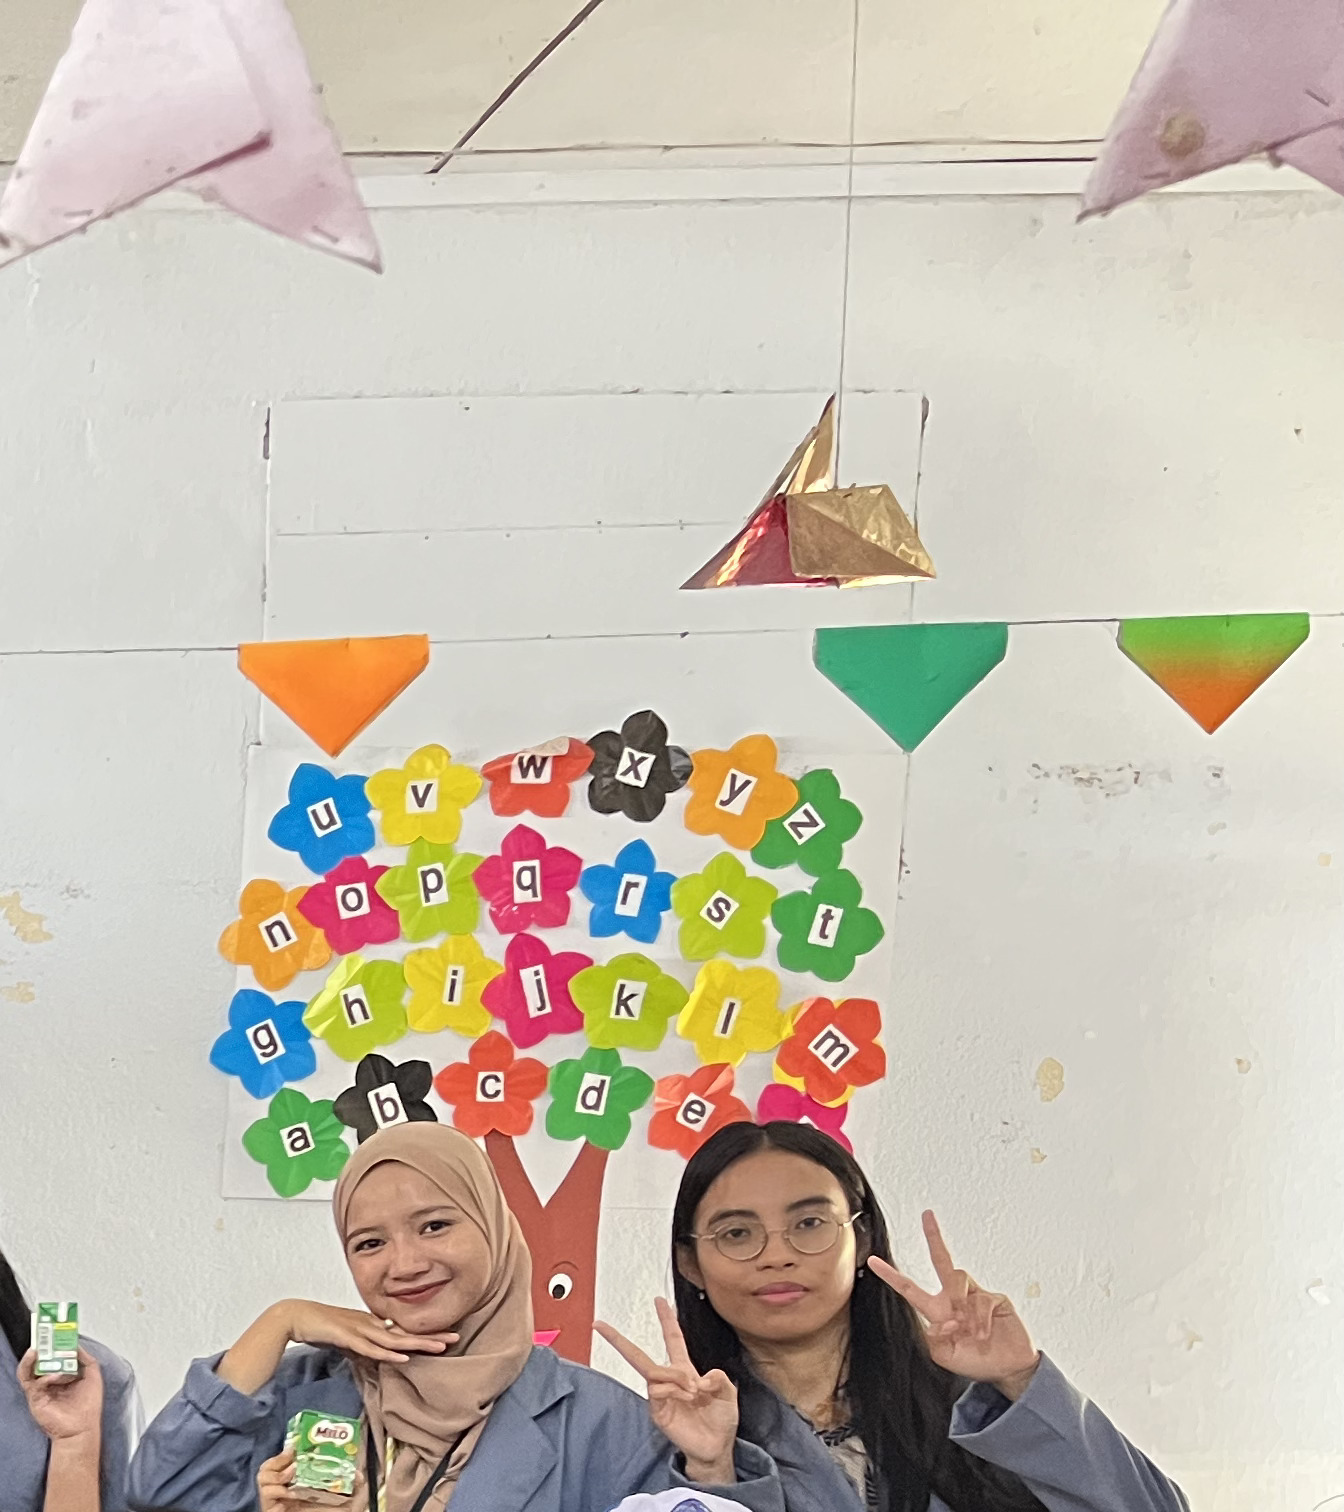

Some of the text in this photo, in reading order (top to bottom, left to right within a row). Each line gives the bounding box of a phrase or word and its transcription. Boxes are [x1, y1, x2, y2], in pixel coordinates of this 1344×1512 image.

[311, 803, 337, 830] u
[719, 773, 752, 806] y
[265, 920, 291, 947] n
[421, 868, 443, 903] p
[516, 866, 538, 898] q
[620, 881, 639, 905] r
[707, 897, 731, 922] s
[819, 909, 834, 939] t
[253, 1024, 278, 1057] g
[343, 994, 369, 1025] h
[448, 970, 458, 1002] i
[531, 970, 547, 1011] j
[615, 984, 638, 1017] k
[813, 1030, 849, 1067] m
[287, 1074, 706, 1152] a b c d e
[315, 1427, 349, 1440] MILO
